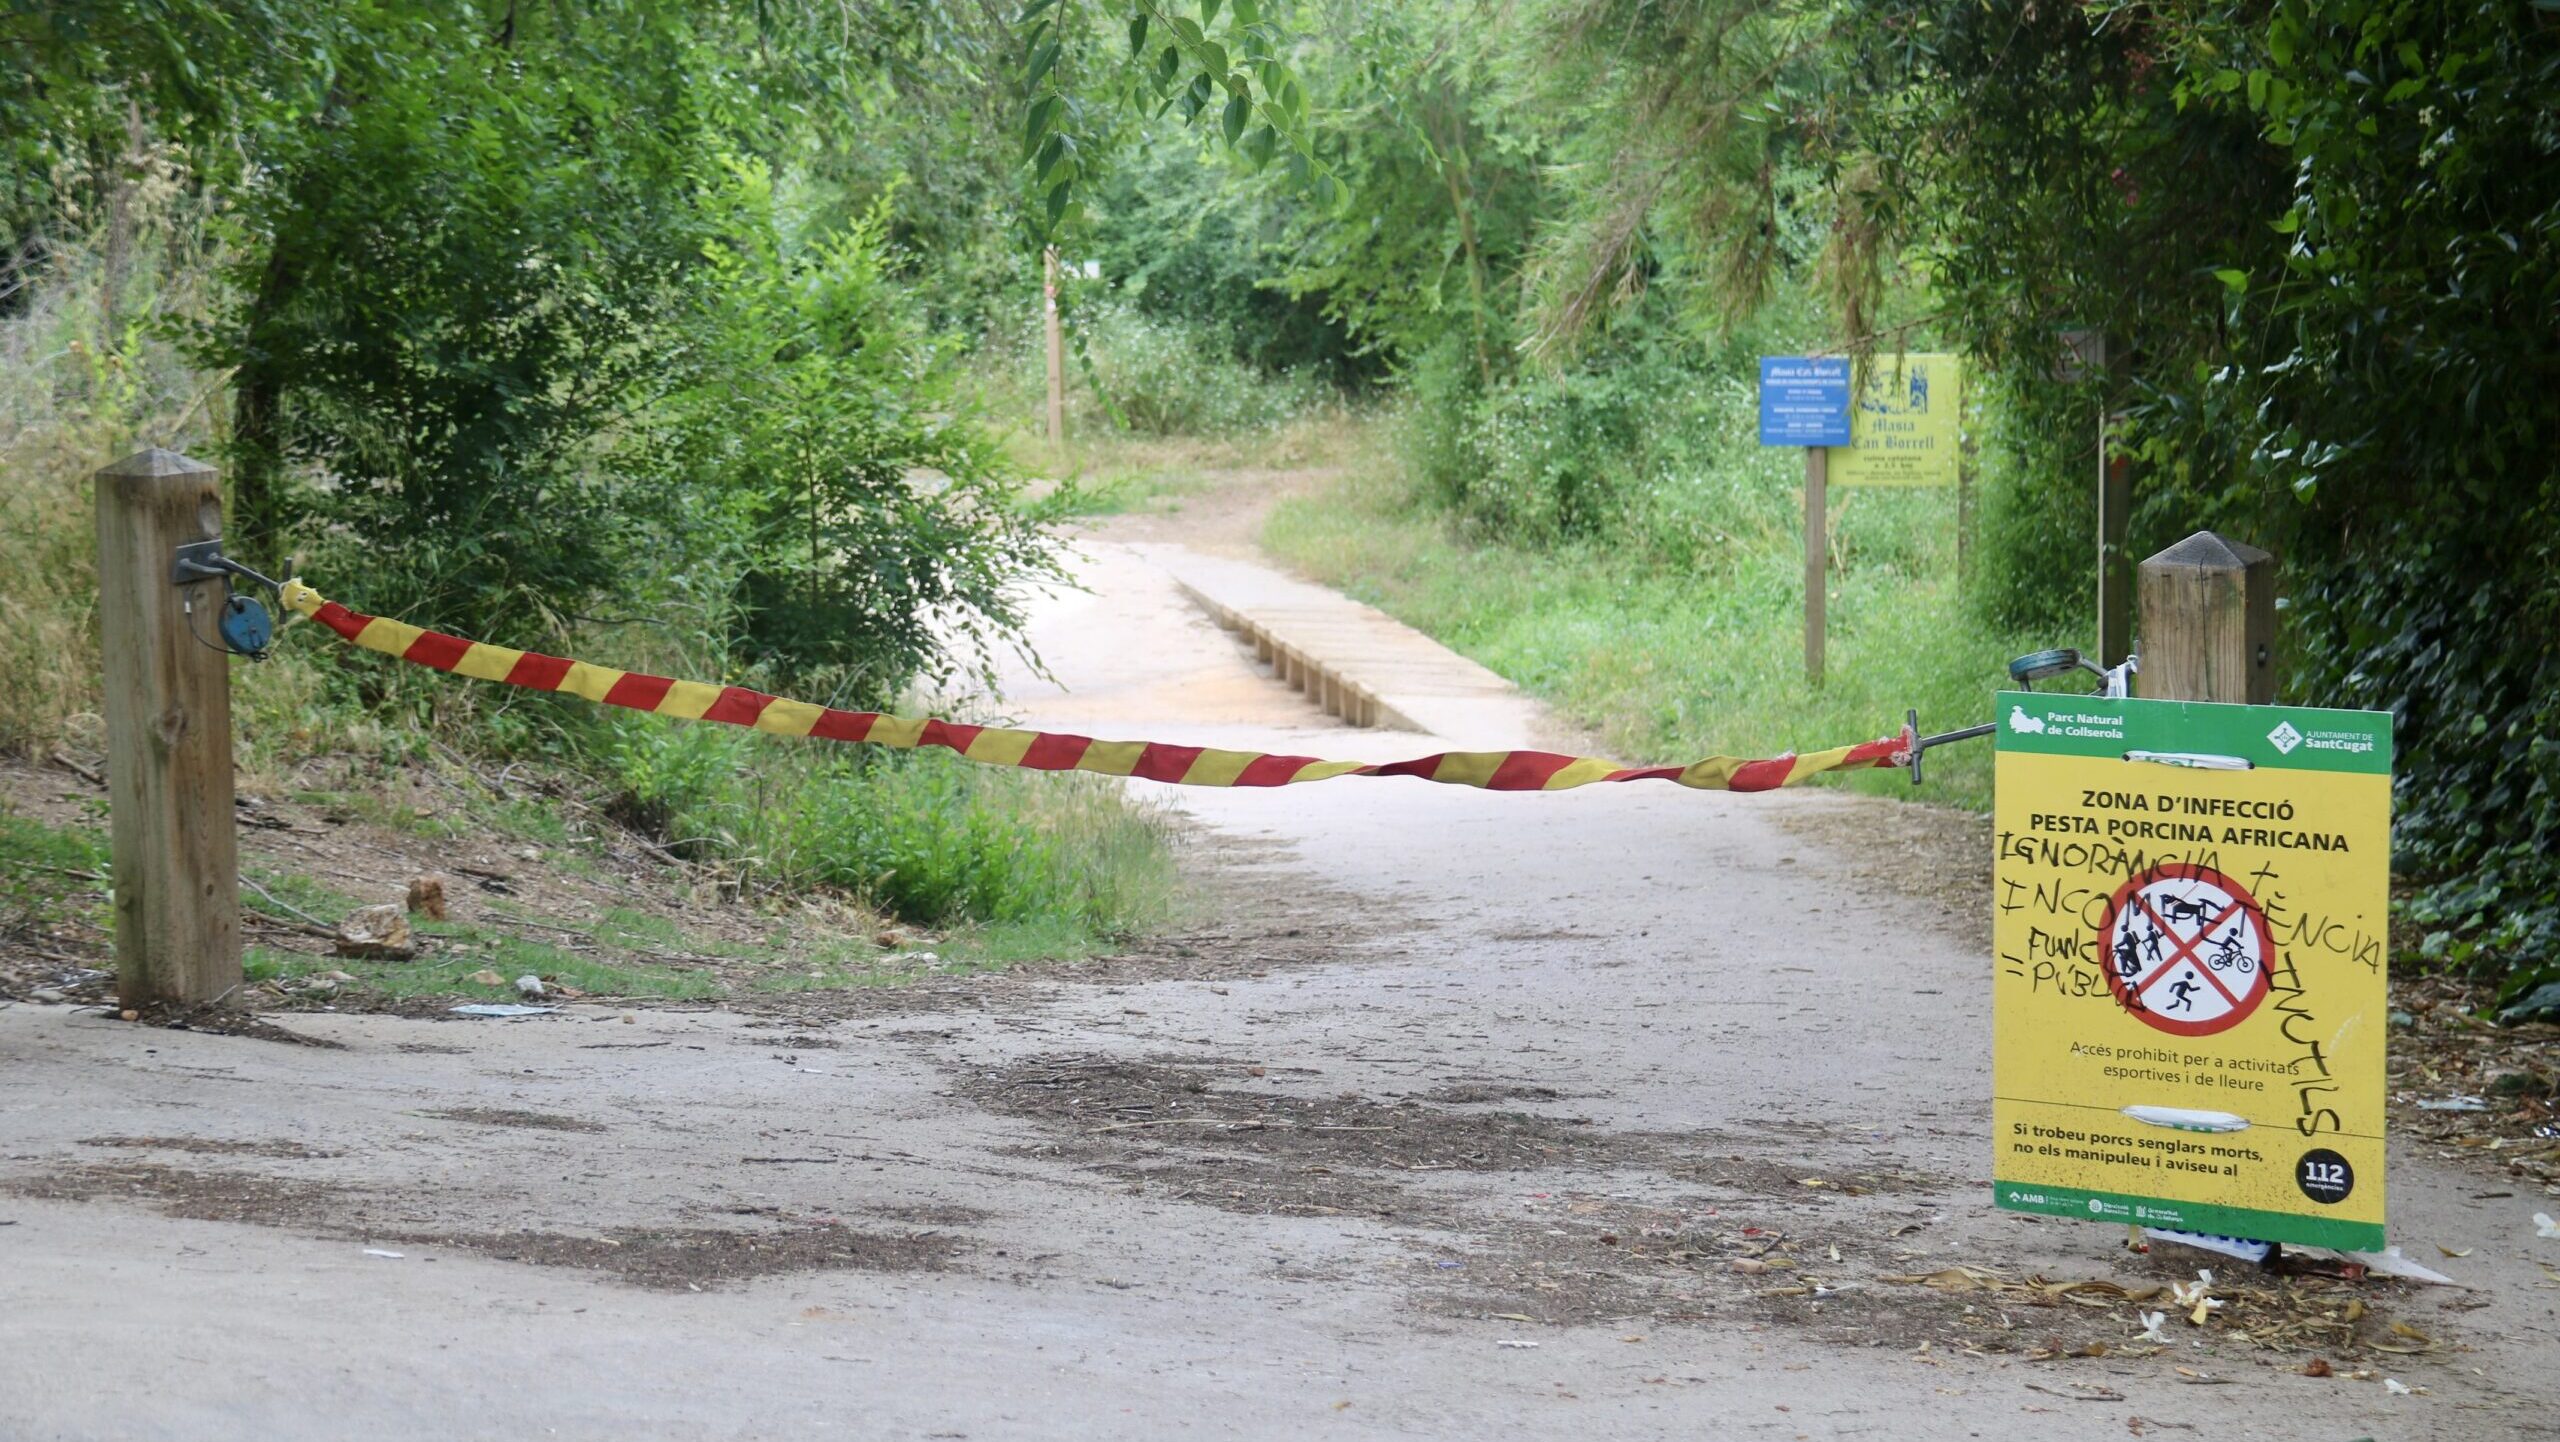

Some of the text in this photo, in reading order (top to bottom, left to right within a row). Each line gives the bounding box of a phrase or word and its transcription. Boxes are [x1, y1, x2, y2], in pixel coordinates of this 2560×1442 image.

[2047, 712, 2123, 725] Parc Natural
[2047, 725, 2123, 739] de Collserola
[2306, 731, 2373, 741] AJUNTAMENT DE
[2305, 738, 2374, 753] SantCugat
[2082, 790, 2149, 811] ZONA
[2030, 813, 2350, 852] PESTA PORCINA AFRICANA
[2070, 1041, 2300, 1076] Accés prohibit per a activitats
[2103, 1066, 2264, 1091] esportives i de lleure
[2013, 1123, 2263, 1162] Si trobeu porcs senglars morts,
[2013, 1143, 2238, 1176] no els manipuleu i aviseu al
[2305, 1162, 2344, 1183] 112
[2022, 1193, 2045, 1204] AMB
